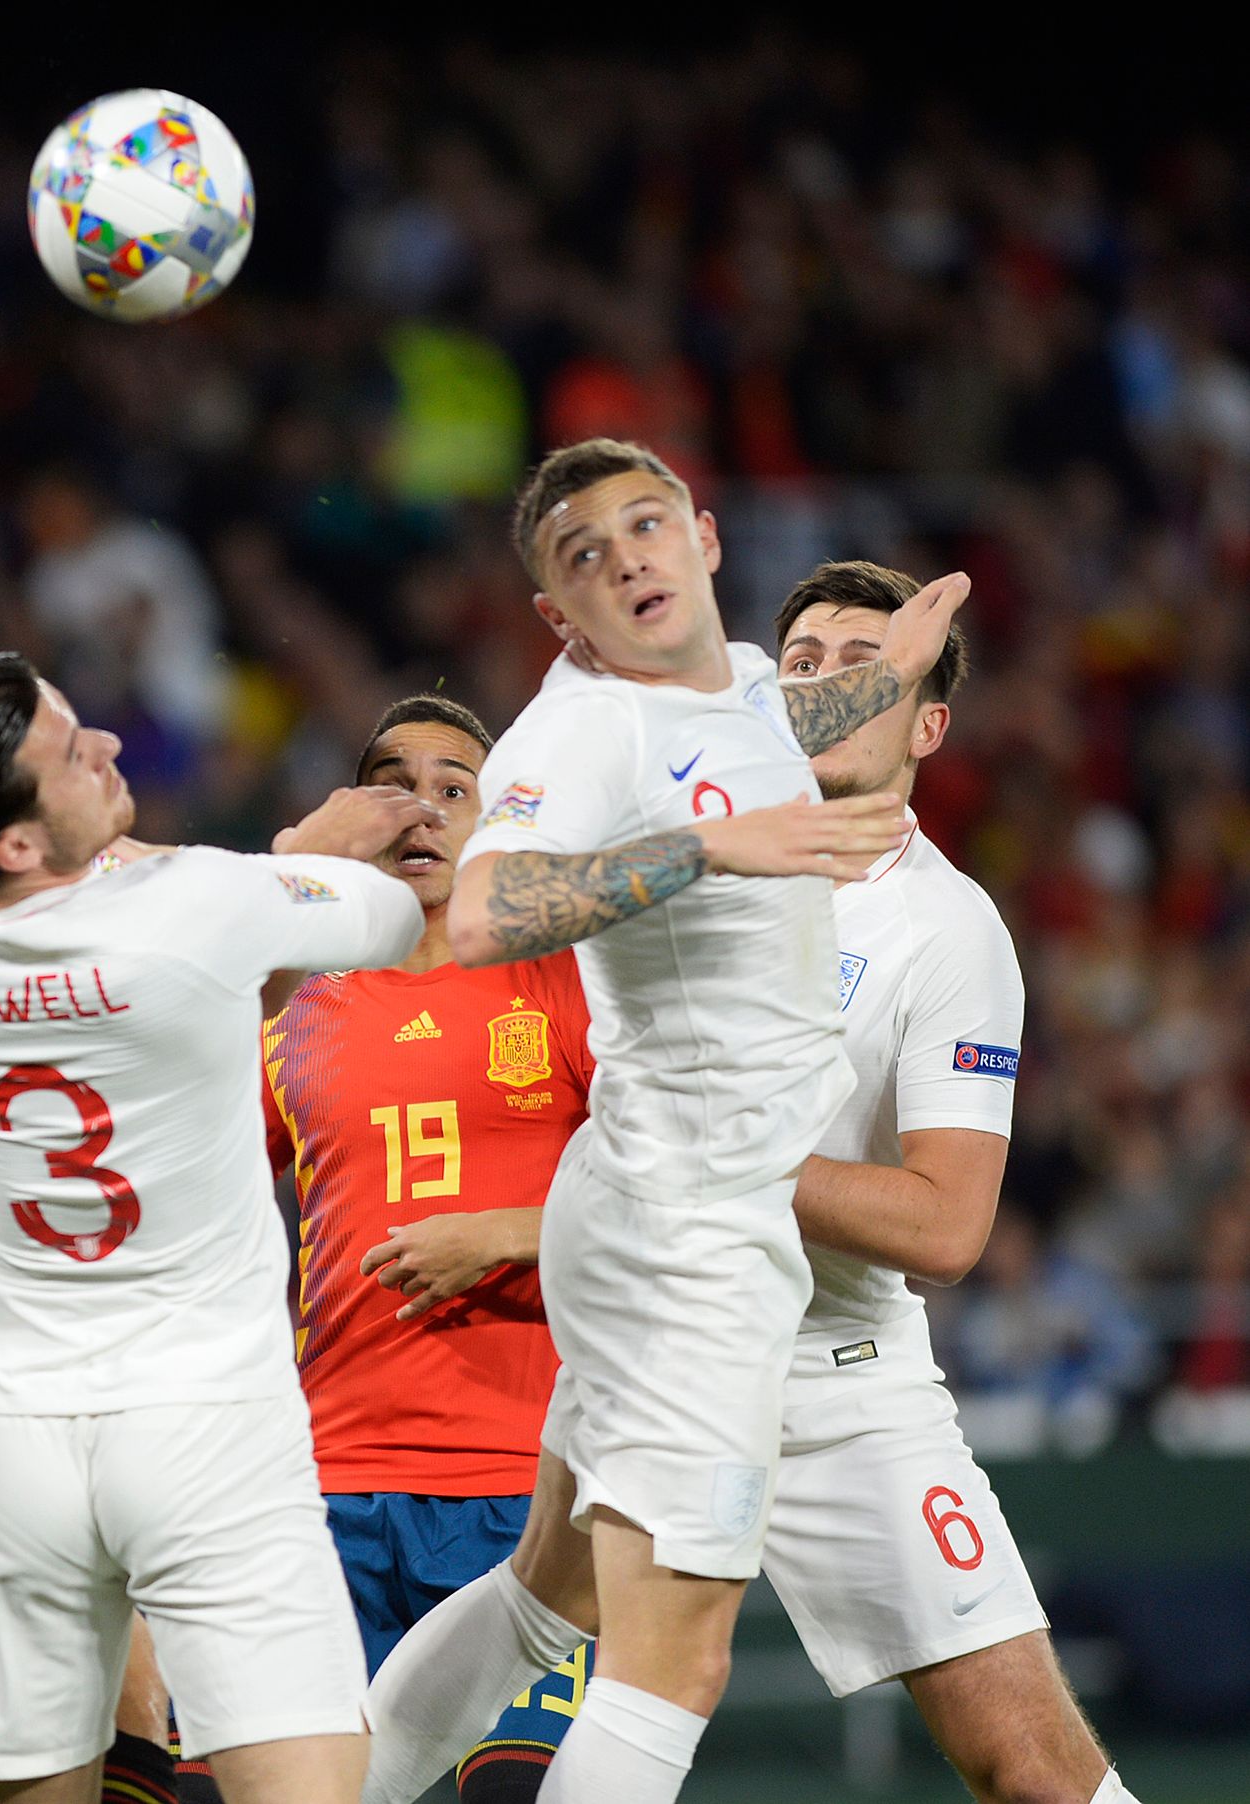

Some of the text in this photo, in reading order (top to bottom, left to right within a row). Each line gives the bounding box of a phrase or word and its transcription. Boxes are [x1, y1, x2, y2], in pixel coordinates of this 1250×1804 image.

[393, 1028, 443, 1043] adidas
[370, 1100, 461, 1203] 19
[922, 1485, 985, 1571] 6
